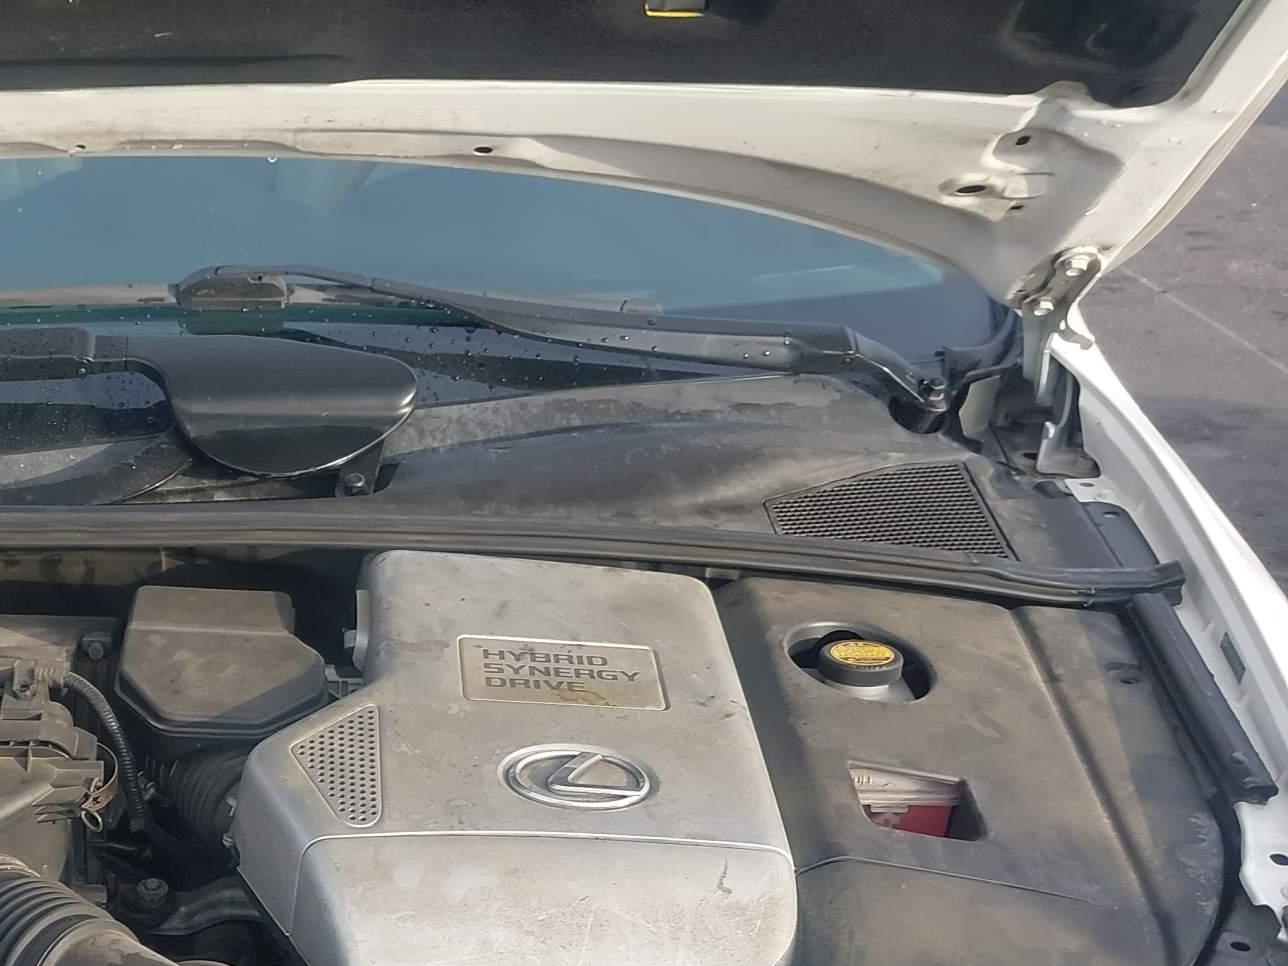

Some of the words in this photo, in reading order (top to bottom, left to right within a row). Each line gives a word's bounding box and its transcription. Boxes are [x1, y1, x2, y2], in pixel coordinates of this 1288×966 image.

[482, 649, 608, 666] HYBRID
[483, 662, 641, 682] SYNERGY
[485, 677, 585, 692] DRIVE
